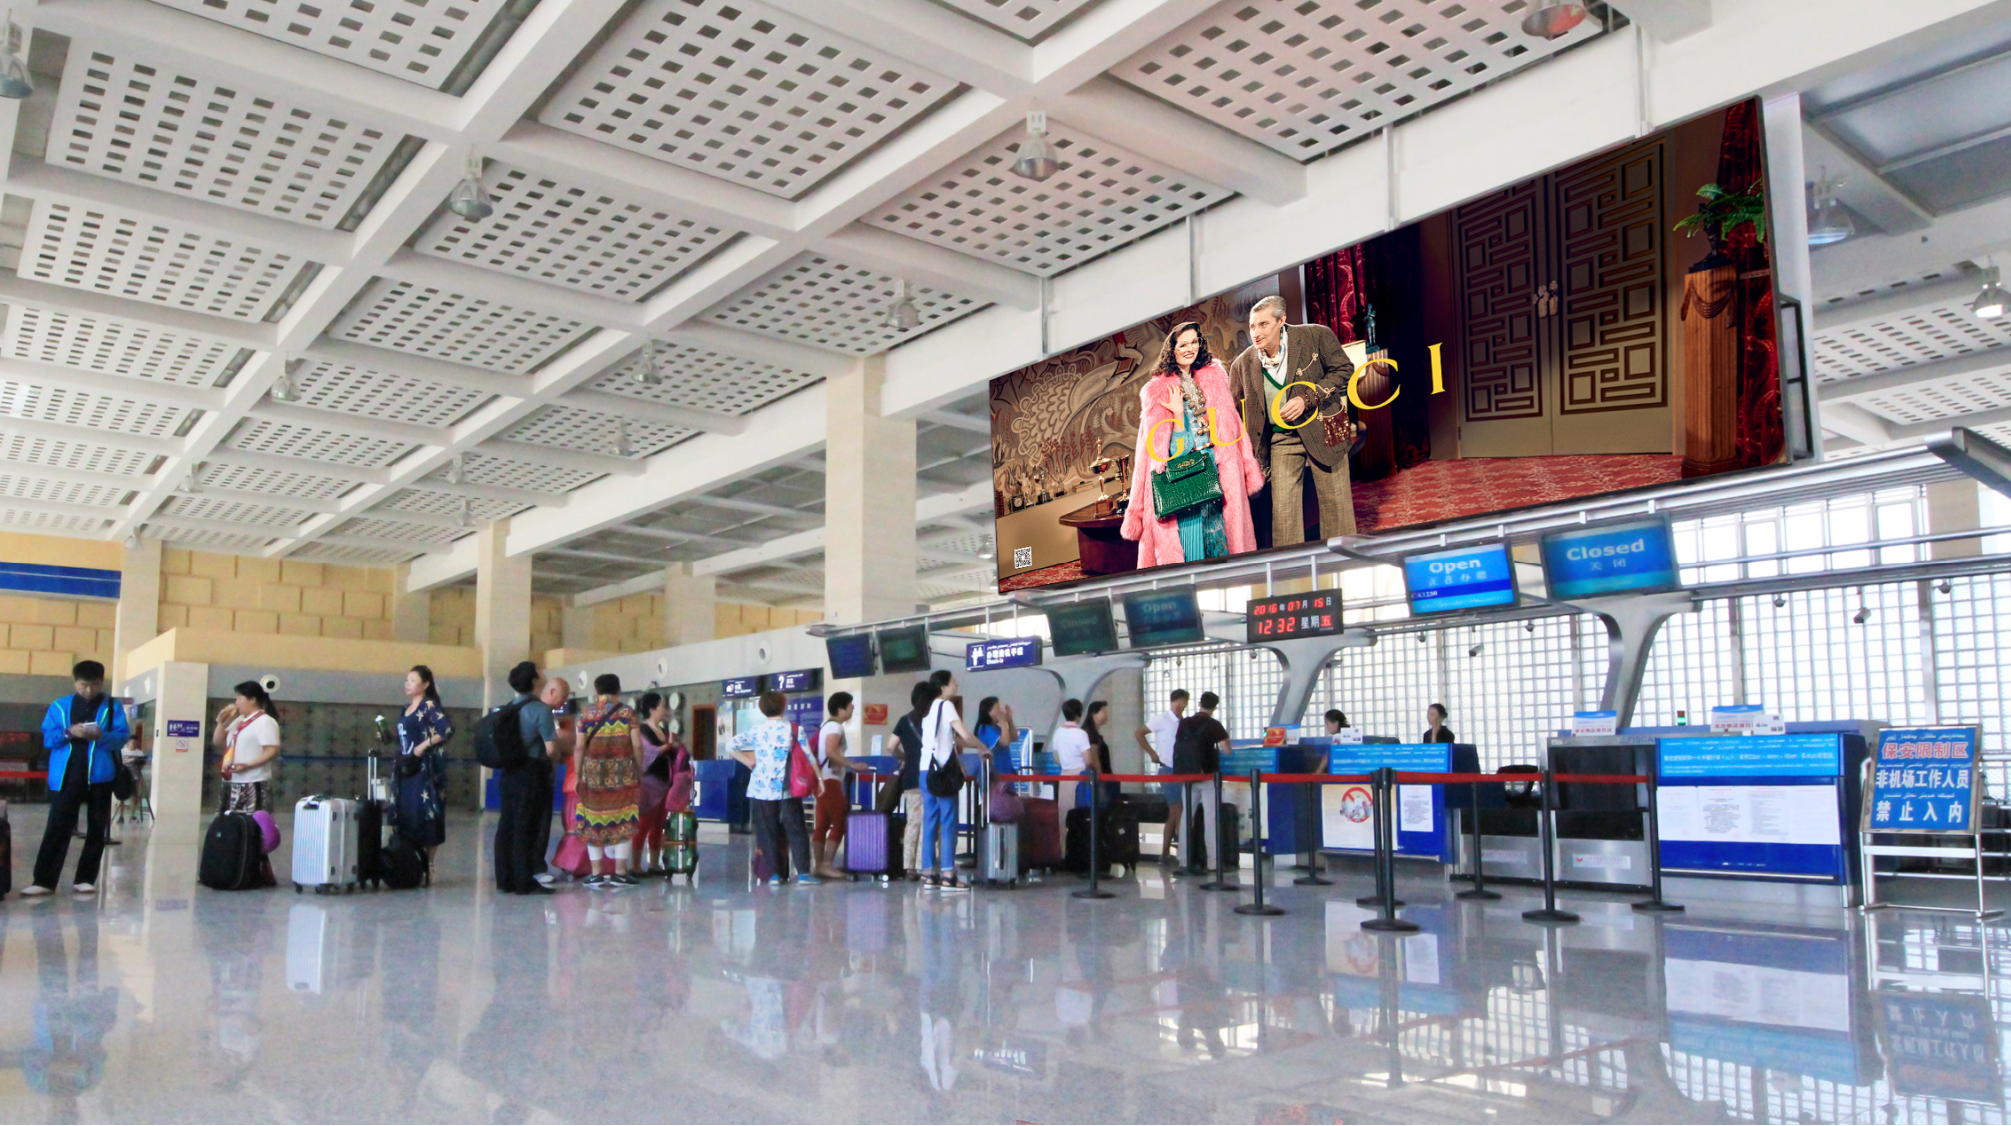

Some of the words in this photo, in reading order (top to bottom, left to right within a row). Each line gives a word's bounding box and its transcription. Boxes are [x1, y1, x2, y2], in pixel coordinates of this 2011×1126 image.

[1146, 342, 1446, 462] GUCCI
[1566, 538, 1645, 561] Closed
[1429, 559, 1481, 574] Open
[1301, 614, 1332, 629] 星期五
[1882, 741, 1969, 760] 保安限制区
[1875, 769, 1969, 789] 非机场工作人员
[1876, 800, 1963, 823] 禁止入内
